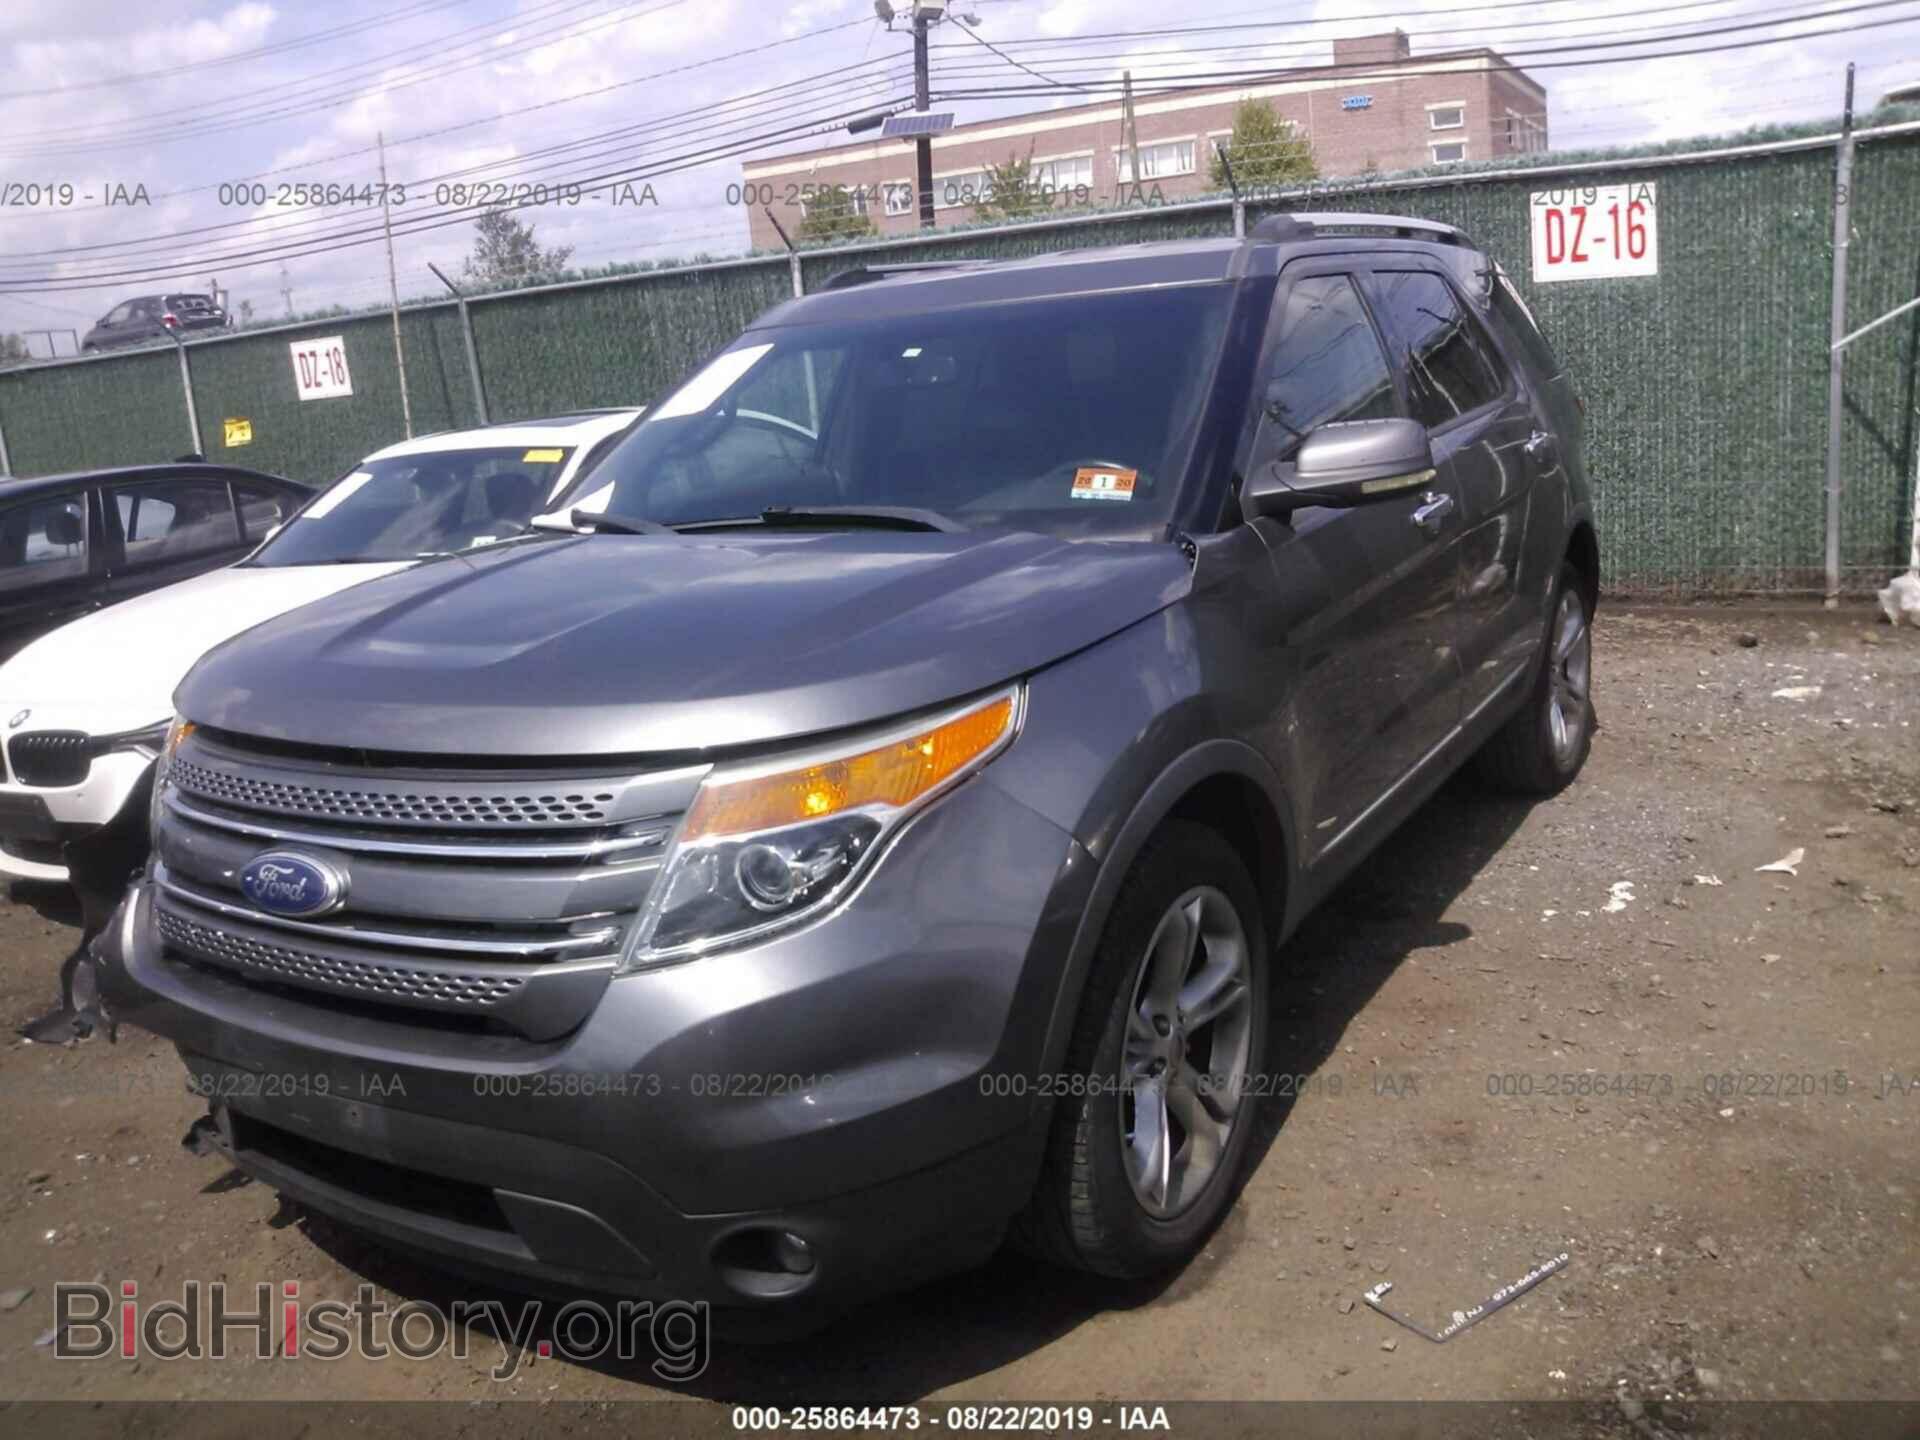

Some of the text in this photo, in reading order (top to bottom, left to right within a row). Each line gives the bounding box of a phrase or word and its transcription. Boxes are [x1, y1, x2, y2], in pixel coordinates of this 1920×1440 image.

[1544, 200, 1647, 264] DZ-16
[298, 346, 345, 389] DZ-18
[254, 863, 308, 901] Ford
